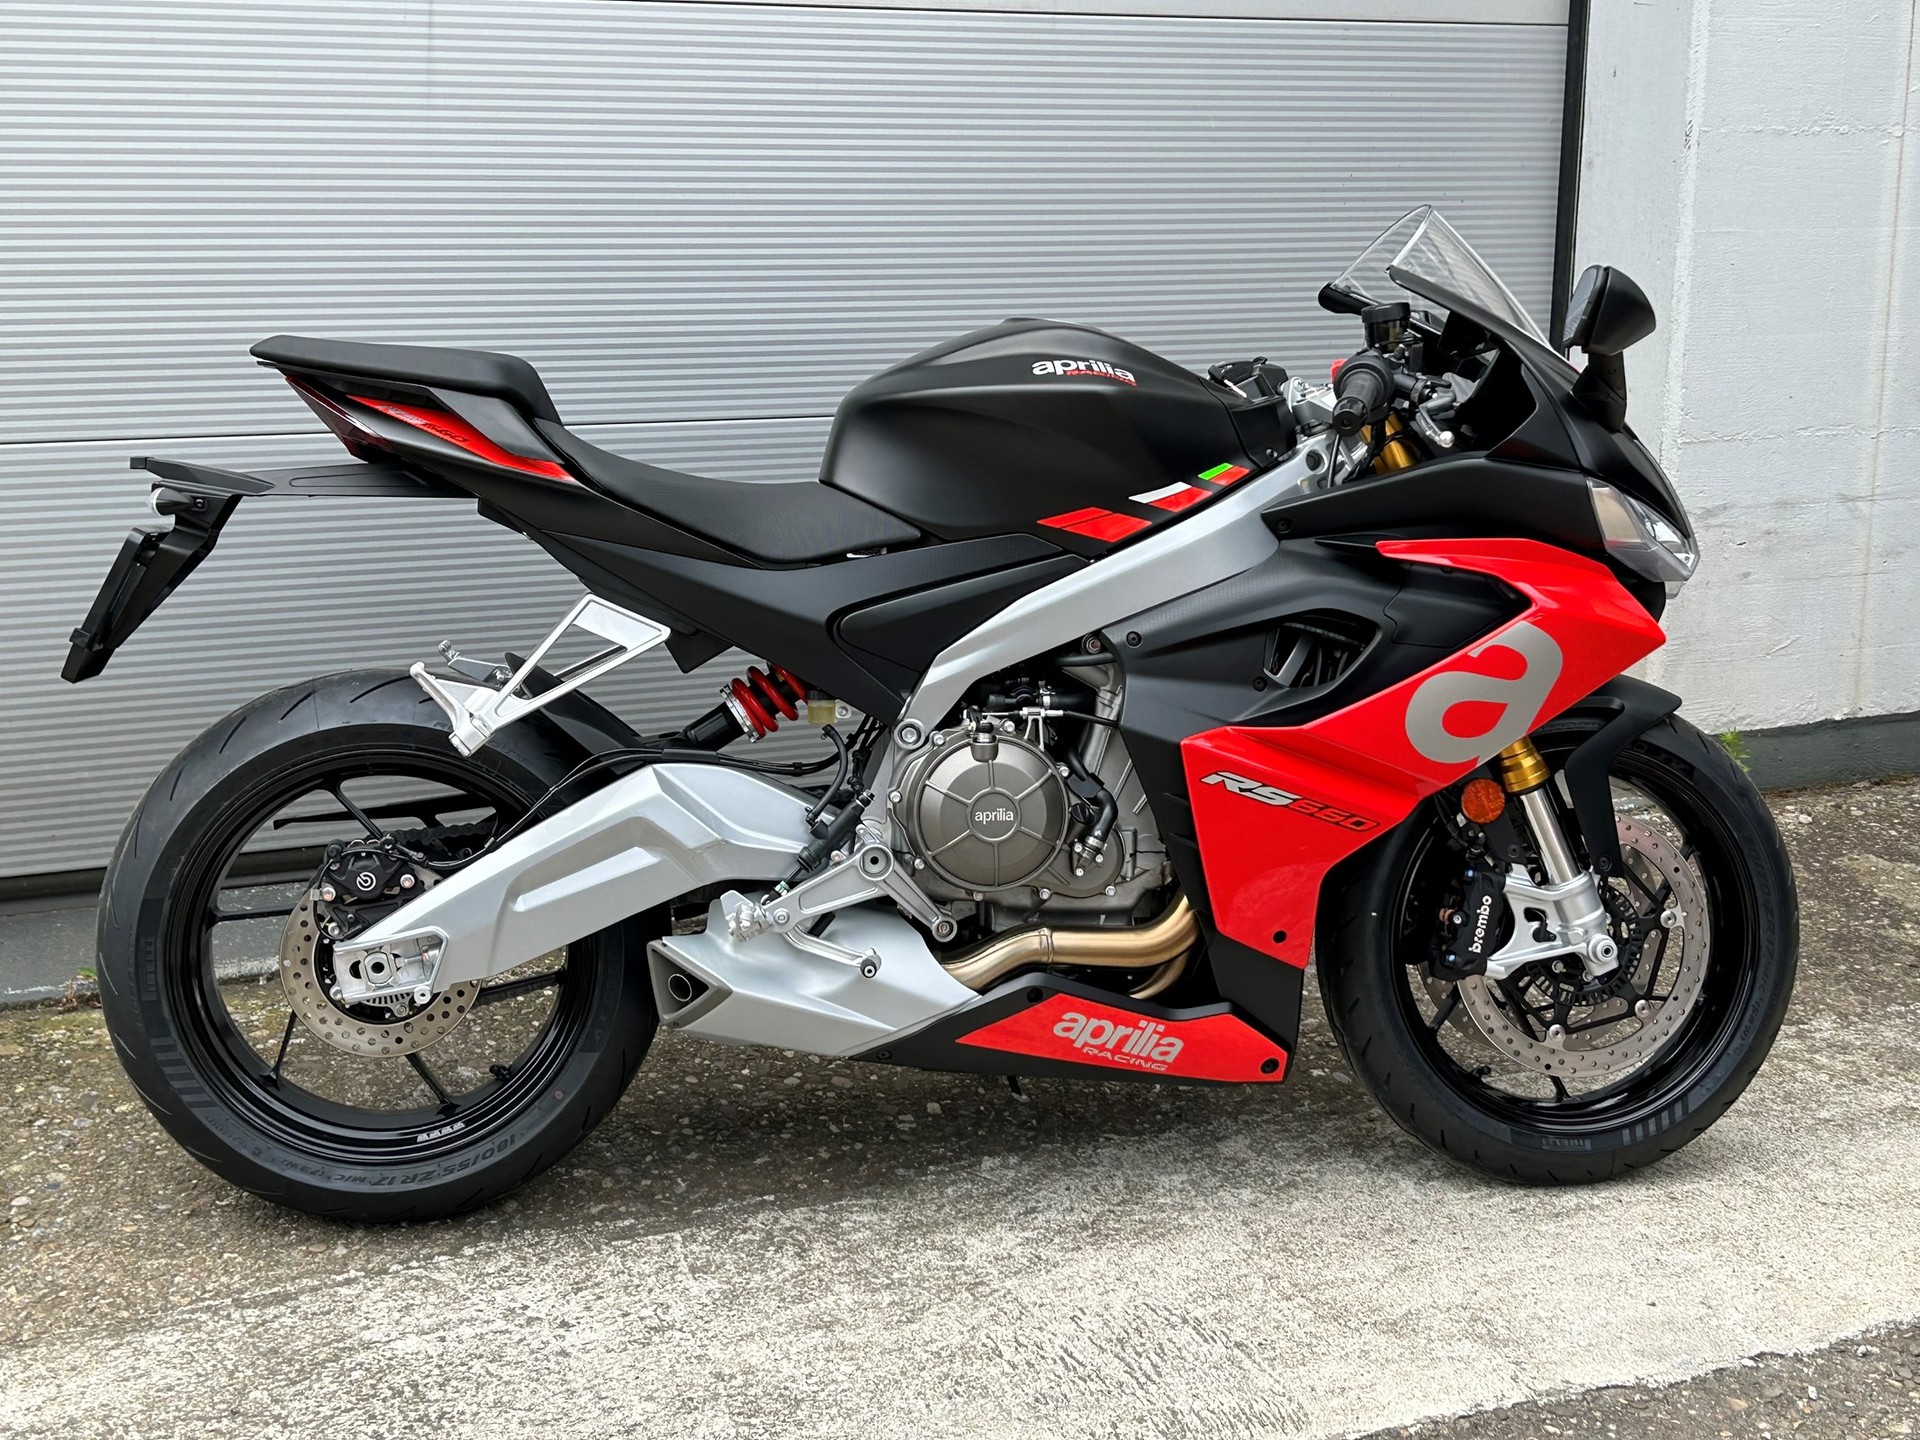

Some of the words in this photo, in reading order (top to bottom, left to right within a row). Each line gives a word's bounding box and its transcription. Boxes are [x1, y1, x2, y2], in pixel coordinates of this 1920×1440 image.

[1031, 360, 1135, 381] aprilia
[974, 807, 1014, 825] aprilia
[1200, 770, 1381, 832] RS660
[1468, 895, 1493, 954] brembo
[1053, 1012, 1185, 1063] aprilia
[1082, 1046, 1169, 1072] RACING
[439, 1132, 520, 1177] 180/55
